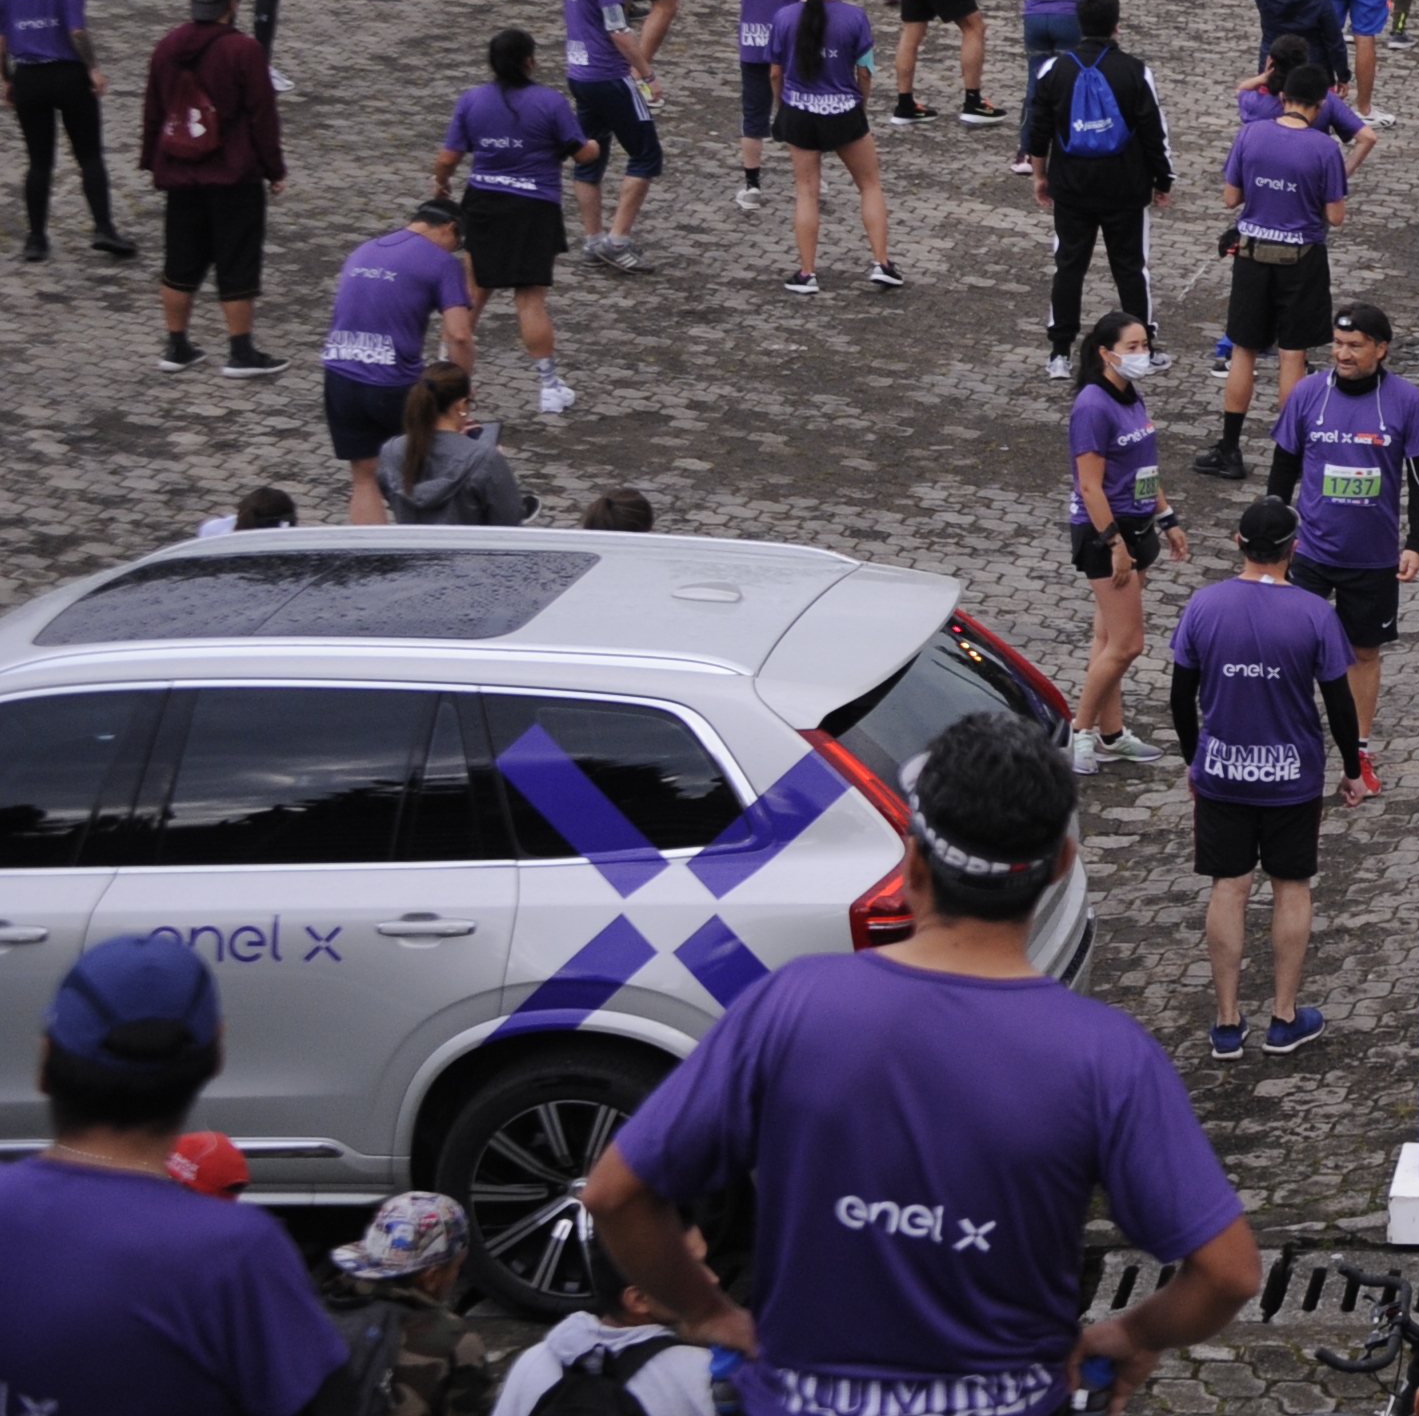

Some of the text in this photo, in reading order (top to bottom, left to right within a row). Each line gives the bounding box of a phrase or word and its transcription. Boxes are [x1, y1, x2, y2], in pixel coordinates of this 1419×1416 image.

[481, 137, 509, 148] enel
[1256, 177, 1284, 192] enel
[350, 266, 383, 278] enel
[348, 346, 396, 365] NOCHE
[1310, 430, 1338, 442] enel
[1330, 477, 1374, 495] 1737
[1223, 663, 1264, 677] enel
[1208, 736, 1300, 765] ILUMINA
[1205, 756, 1300, 782] LA NOCHE
[835, 1195, 996, 1253] enel x
